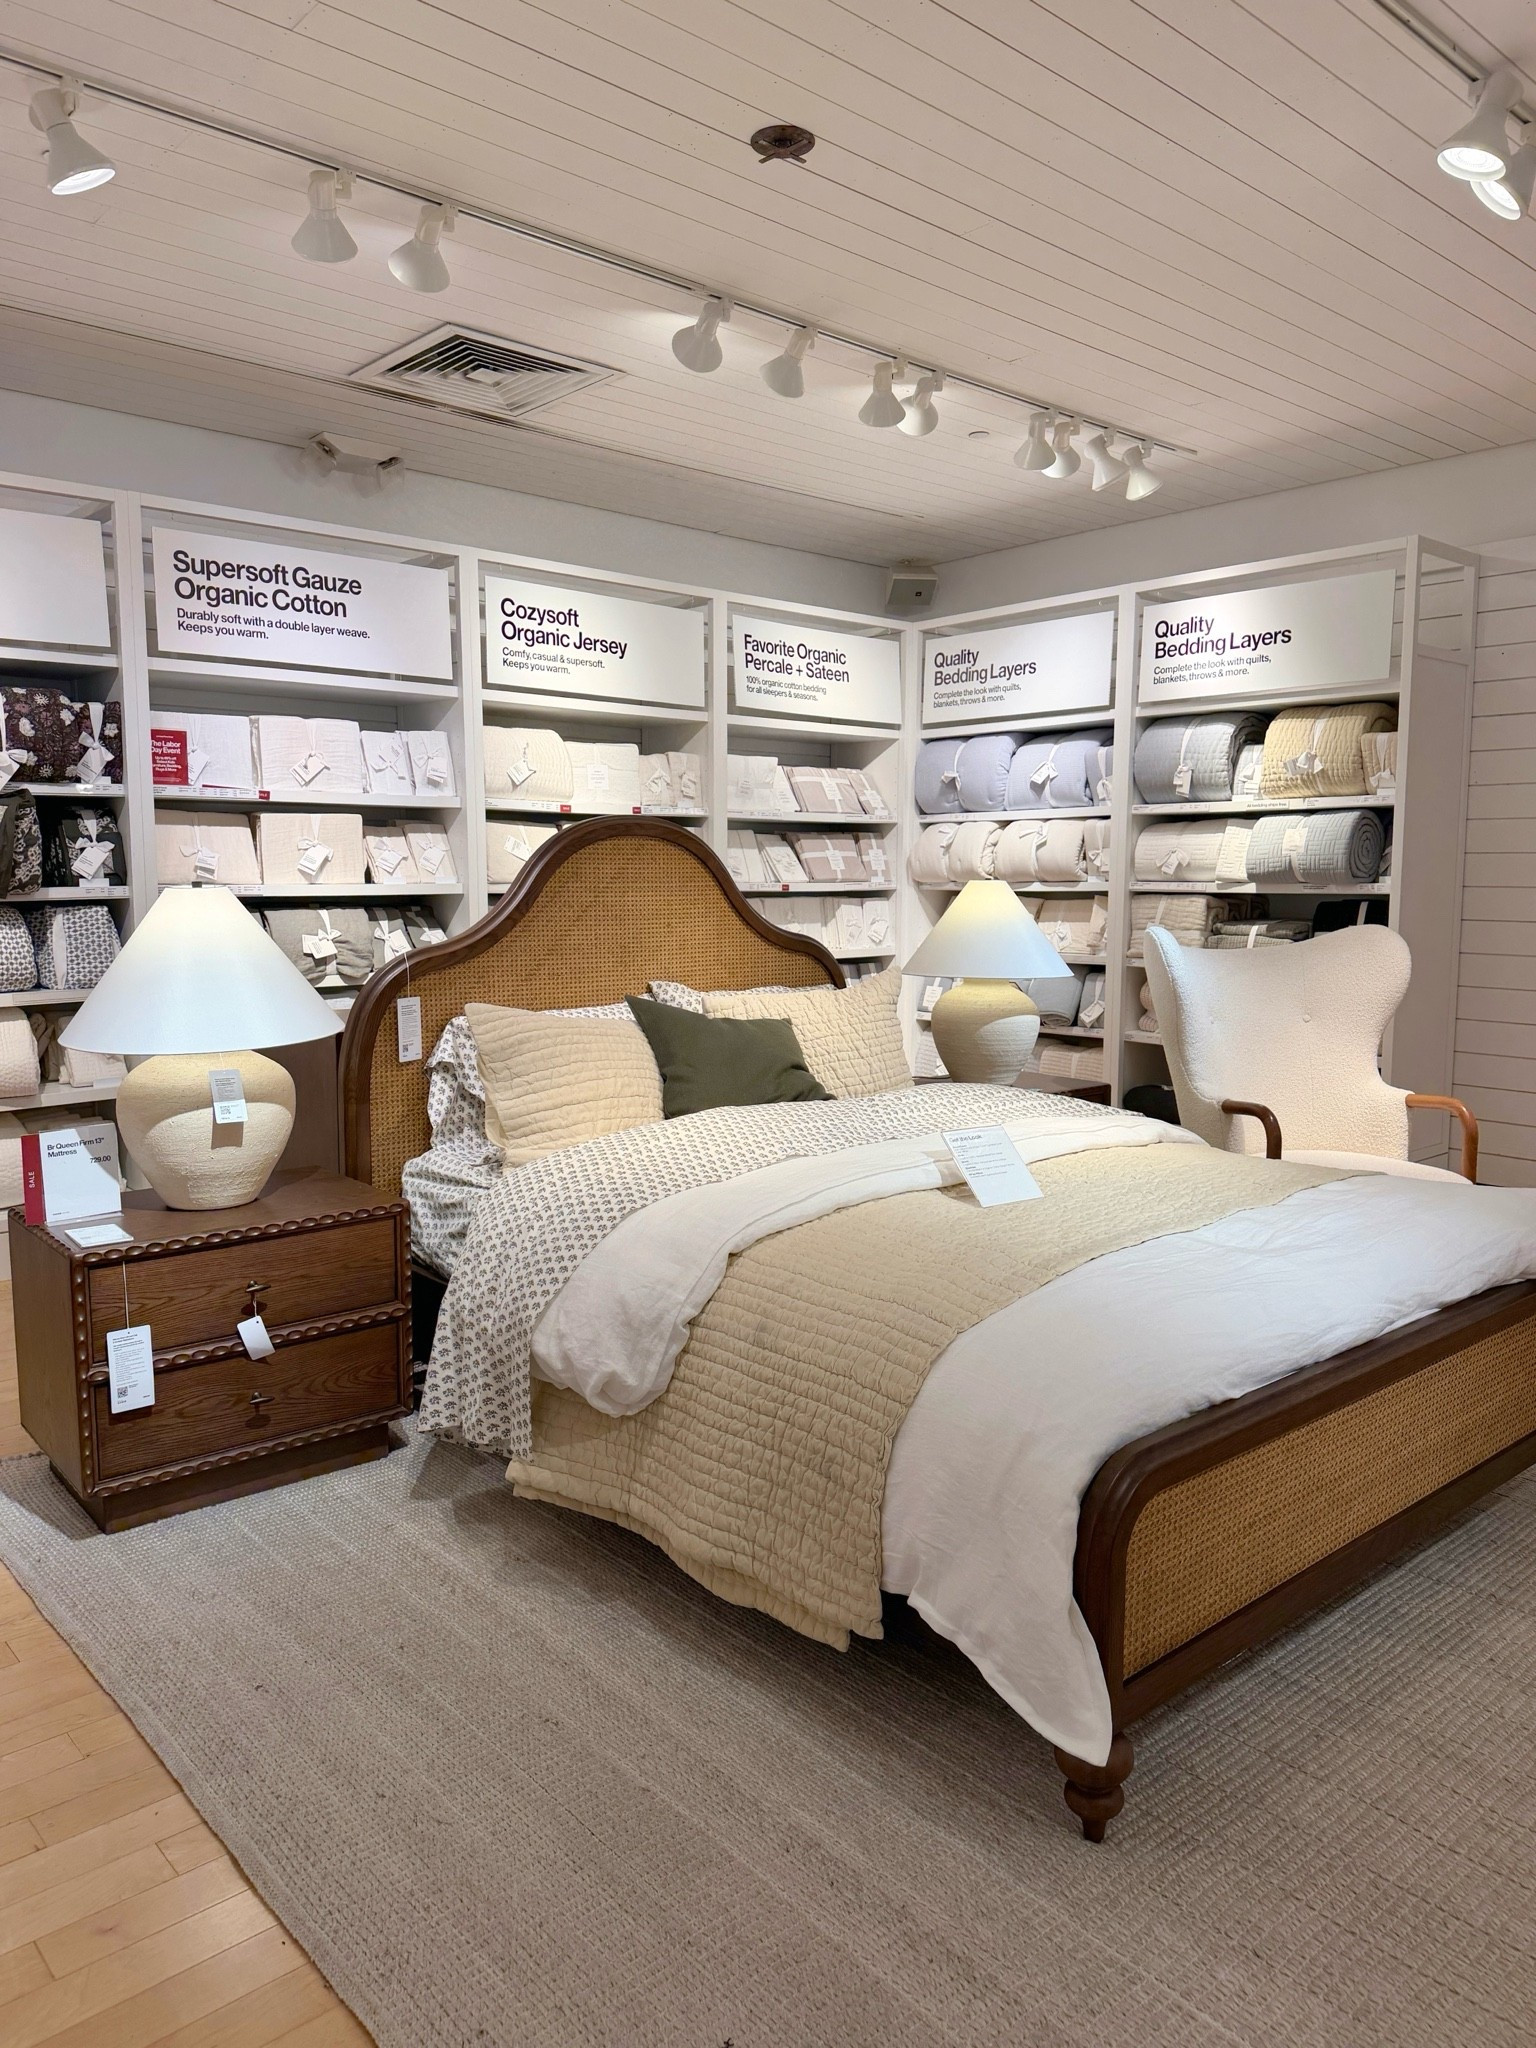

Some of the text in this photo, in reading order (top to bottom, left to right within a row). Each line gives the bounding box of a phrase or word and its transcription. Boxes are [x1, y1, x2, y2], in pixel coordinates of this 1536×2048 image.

[173, 550, 362, 596] Supersoft Gauze
[174, 576, 347, 618] Organic Cotton
[500, 598, 579, 627] Cozysoft
[177, 608, 370, 638] Durably soft with a double layer weave.
[178, 620, 269, 639] Keeps you warm.
[1154, 616, 1214, 639] Quality
[501, 621, 627, 659] Organic Jersey
[744, 634, 846, 665] Favorite Organic
[1154, 628, 1292, 659] Bedding Layers
[503, 647, 605, 669] Comfy, casual & supersoft.
[503, 658, 570, 674] Keeps you warm.
[746, 653, 849, 682] Percale + Sateen
[934, 649, 979, 668] Quality
[1154, 655, 1271, 675] Complete the look with quilts,
[934, 661, 1037, 686] Bedding Layers
[1153, 668, 1249, 685] blankets, throws & more.
[746, 676, 827, 695] 100% organic cotton bedding
[747, 685, 755, 693] for
[763, 688, 787, 698] sleepers
[793, 692, 818, 701] seasons.
[933, 684, 1021, 700] Complete the look with quilts,
[933, 698, 959, 708] blankets,
[960, 697, 981, 705] throws
[151, 746, 163, 755] Day
[162, 740, 181, 748] Labor
[48, 1150, 77, 1158] Mattress
[56, 1141, 78, 1150] Queen
